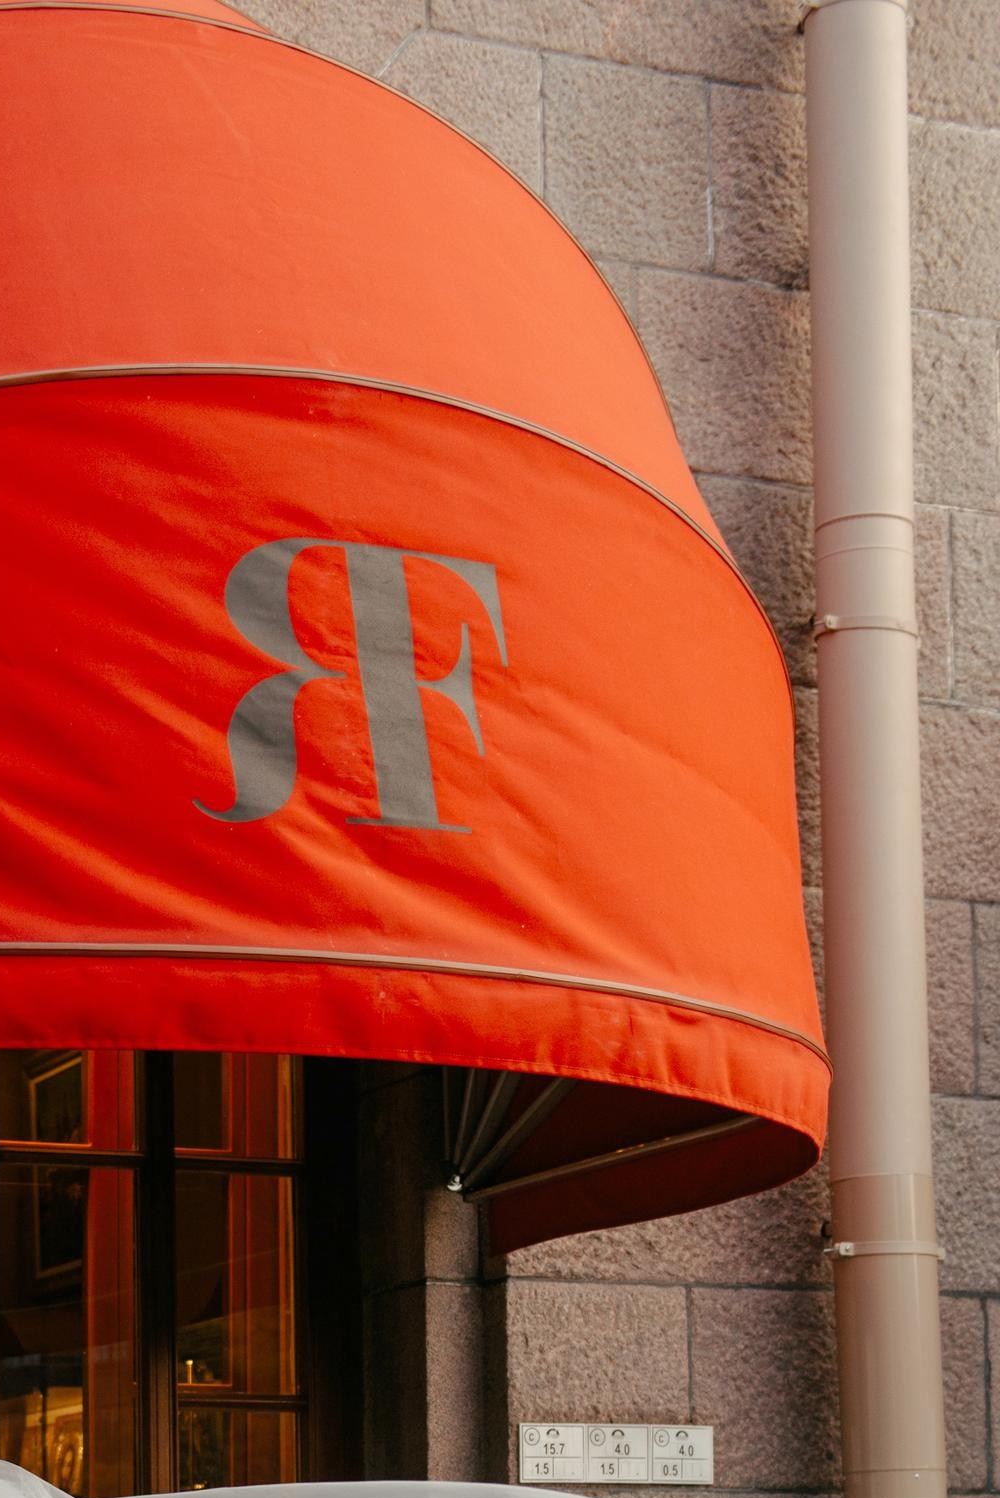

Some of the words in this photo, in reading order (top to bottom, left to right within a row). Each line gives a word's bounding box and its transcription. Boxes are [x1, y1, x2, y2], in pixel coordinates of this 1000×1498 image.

[543, 1443, 565, 1455] 15.7
[614, 1443, 630, 1456] 4.0
[678, 1445, 694, 1457] 4.0
[535, 1463, 550, 1475] 1.5
[600, 1463, 615, 1475] 1.5
[662, 1464, 679, 1476] 0.5
